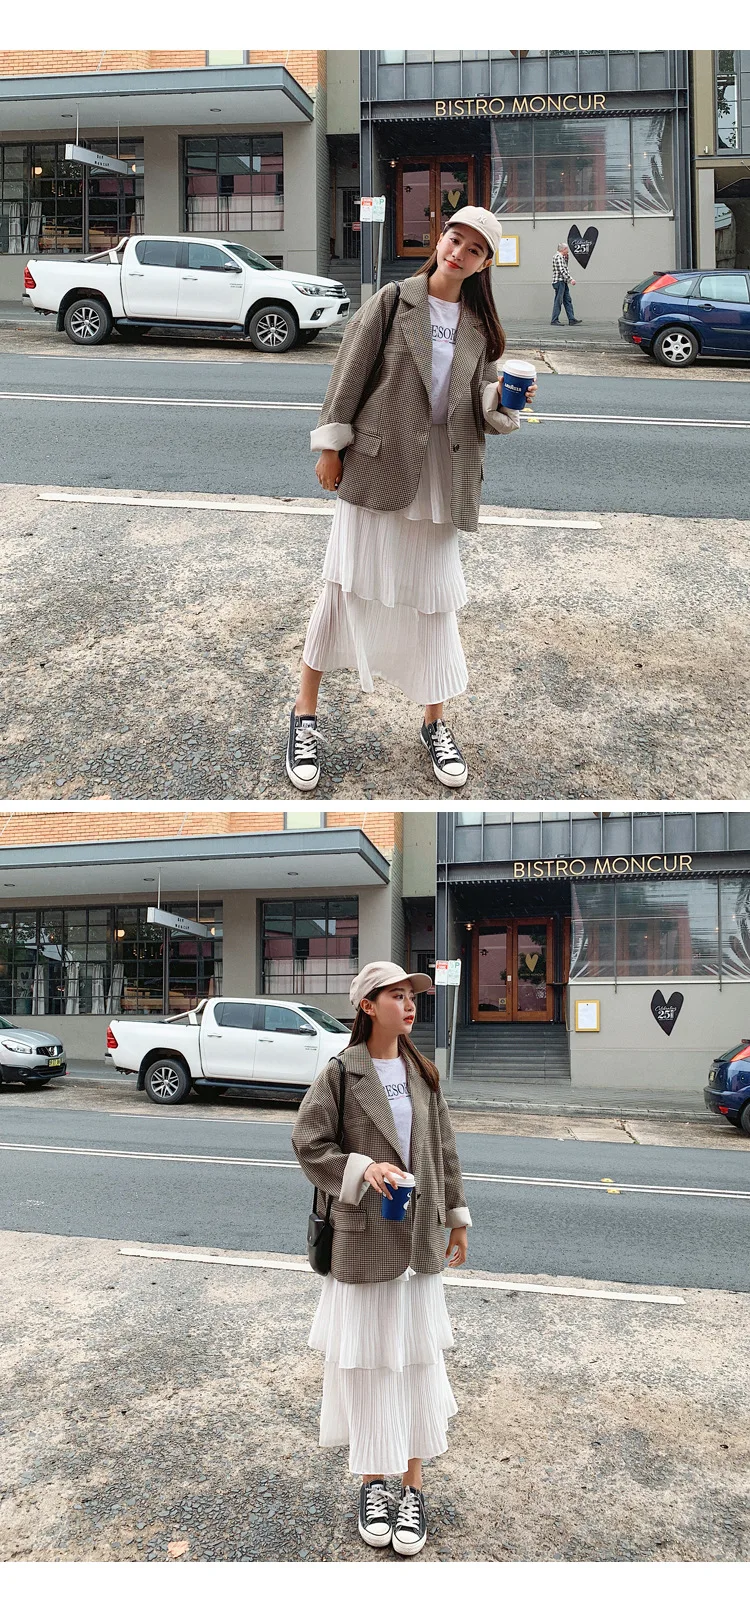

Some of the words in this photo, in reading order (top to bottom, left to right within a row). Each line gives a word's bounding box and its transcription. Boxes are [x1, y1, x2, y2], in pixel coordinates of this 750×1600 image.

[435, 98, 504, 117] BISTRO
[512, 94, 606, 113] MONCUR
[513, 859, 586, 878] BISTRO
[594, 855, 692, 874] MONCUR
